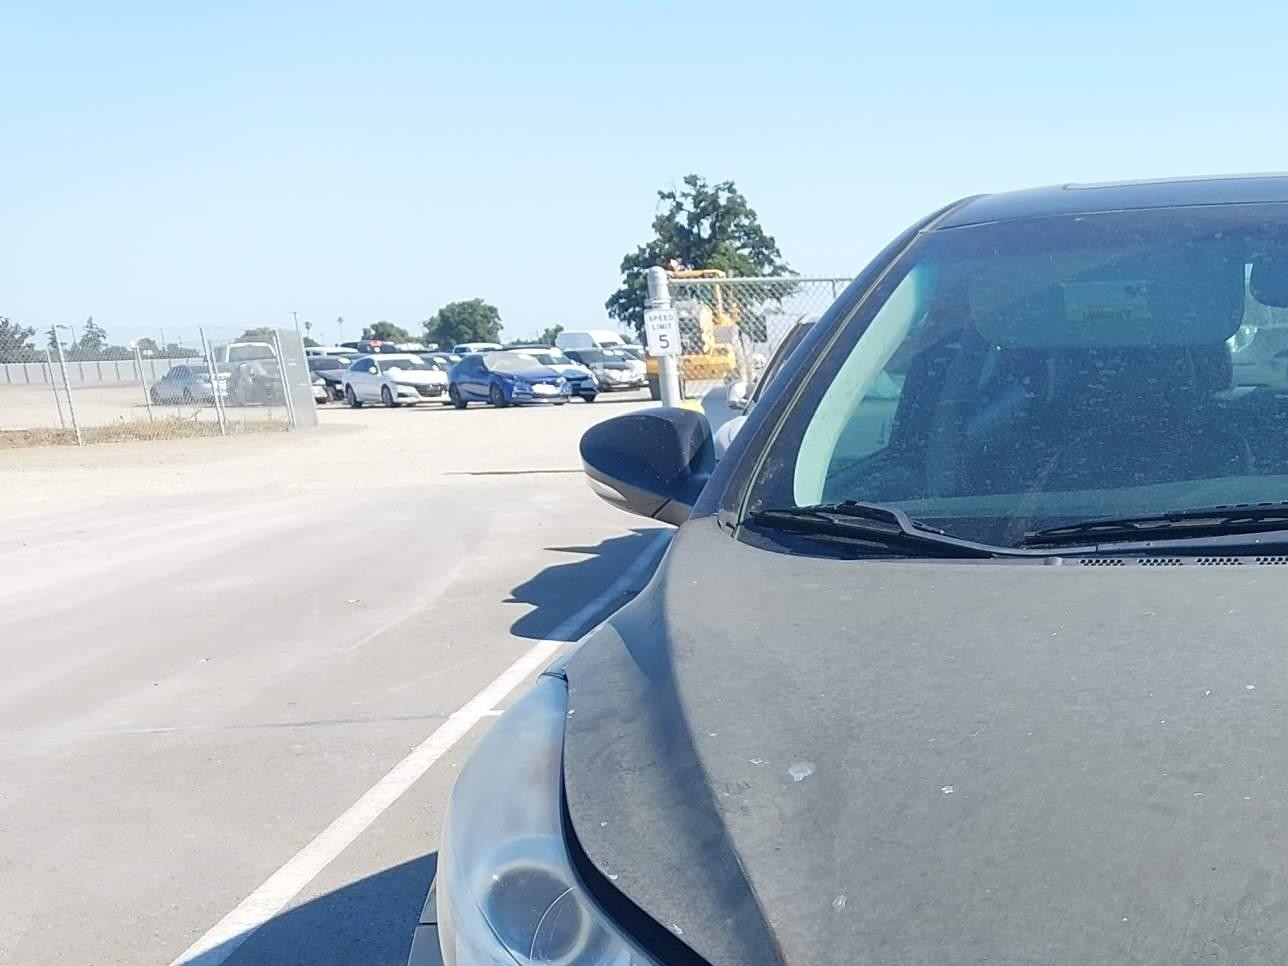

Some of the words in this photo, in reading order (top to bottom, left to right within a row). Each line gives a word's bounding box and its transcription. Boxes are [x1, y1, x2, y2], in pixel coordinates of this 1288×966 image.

[649, 313, 674, 321] SPEED
[652, 323, 672, 331] LIMIT
[658, 334, 670, 349] 5
